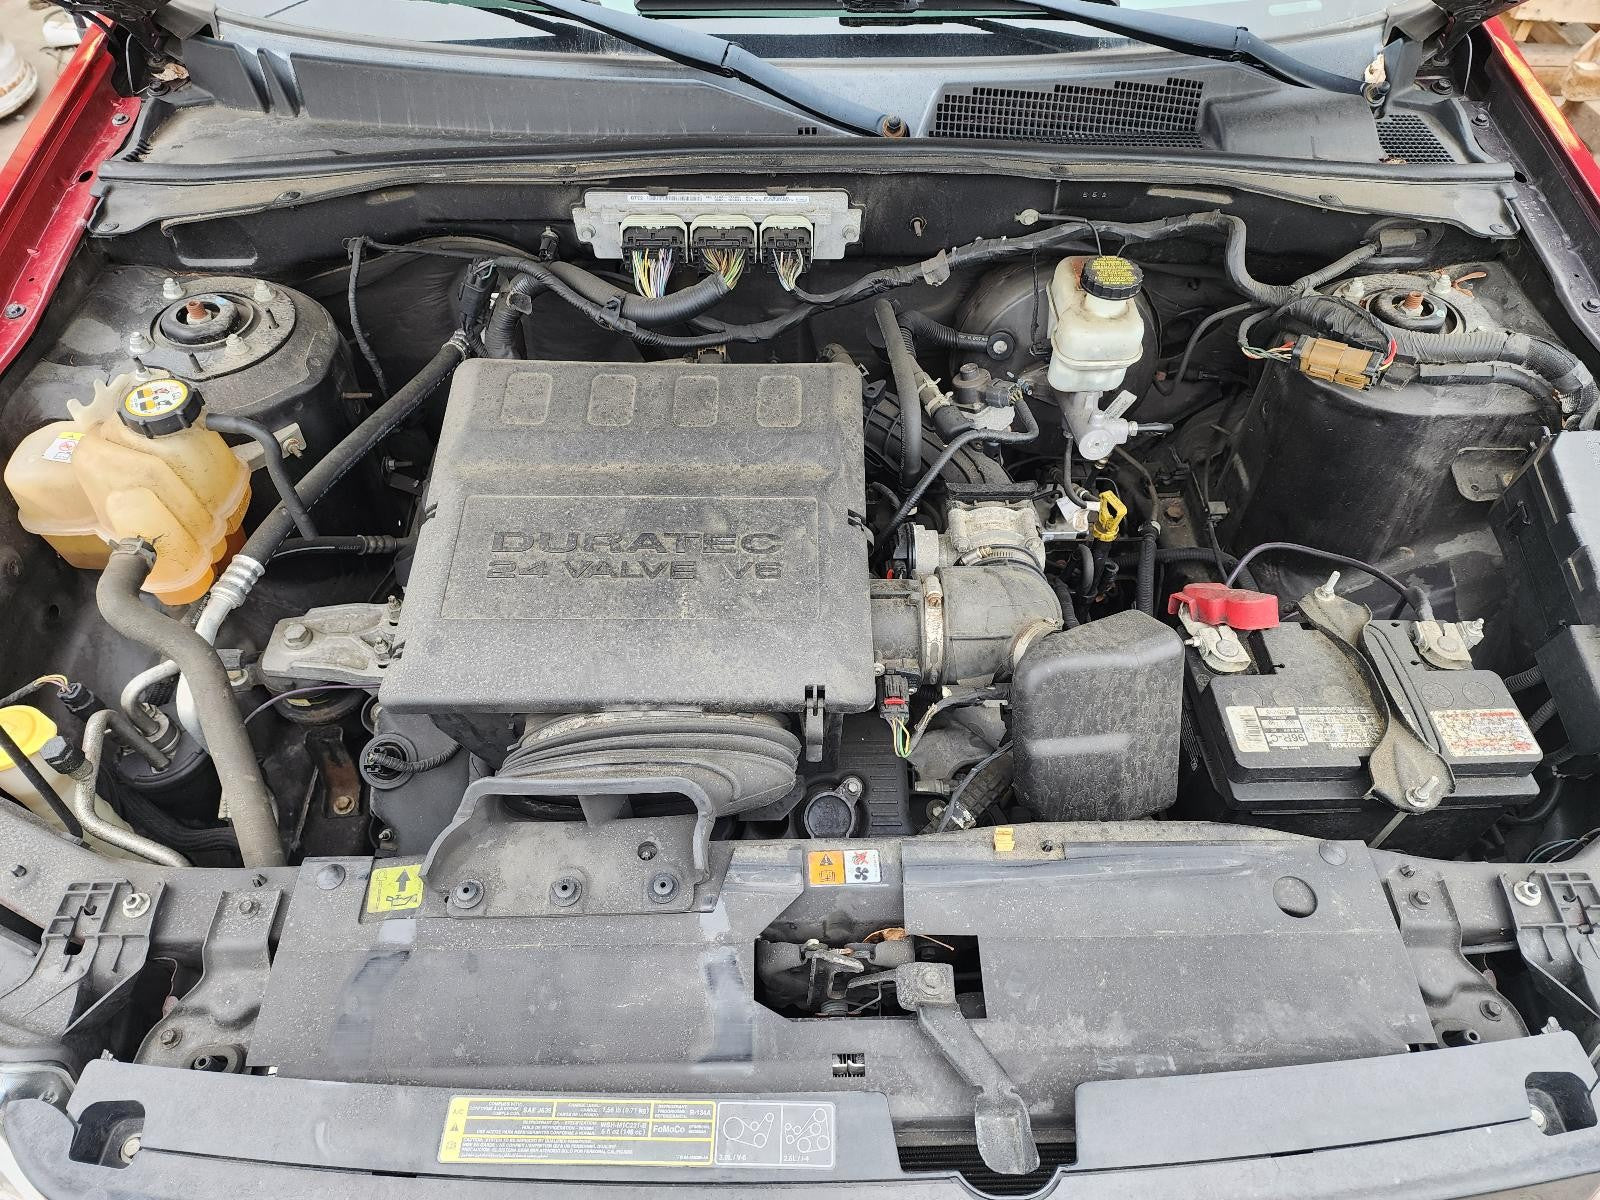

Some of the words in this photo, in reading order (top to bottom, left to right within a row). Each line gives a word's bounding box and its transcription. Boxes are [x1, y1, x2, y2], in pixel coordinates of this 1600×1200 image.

[491, 531, 784, 555] DURATEC
[486, 560, 549, 579] 24
[562, 560, 696, 580] VALVE
[723, 561, 783, 580] V6
[652, 1124, 686, 1134] FoMoCo
